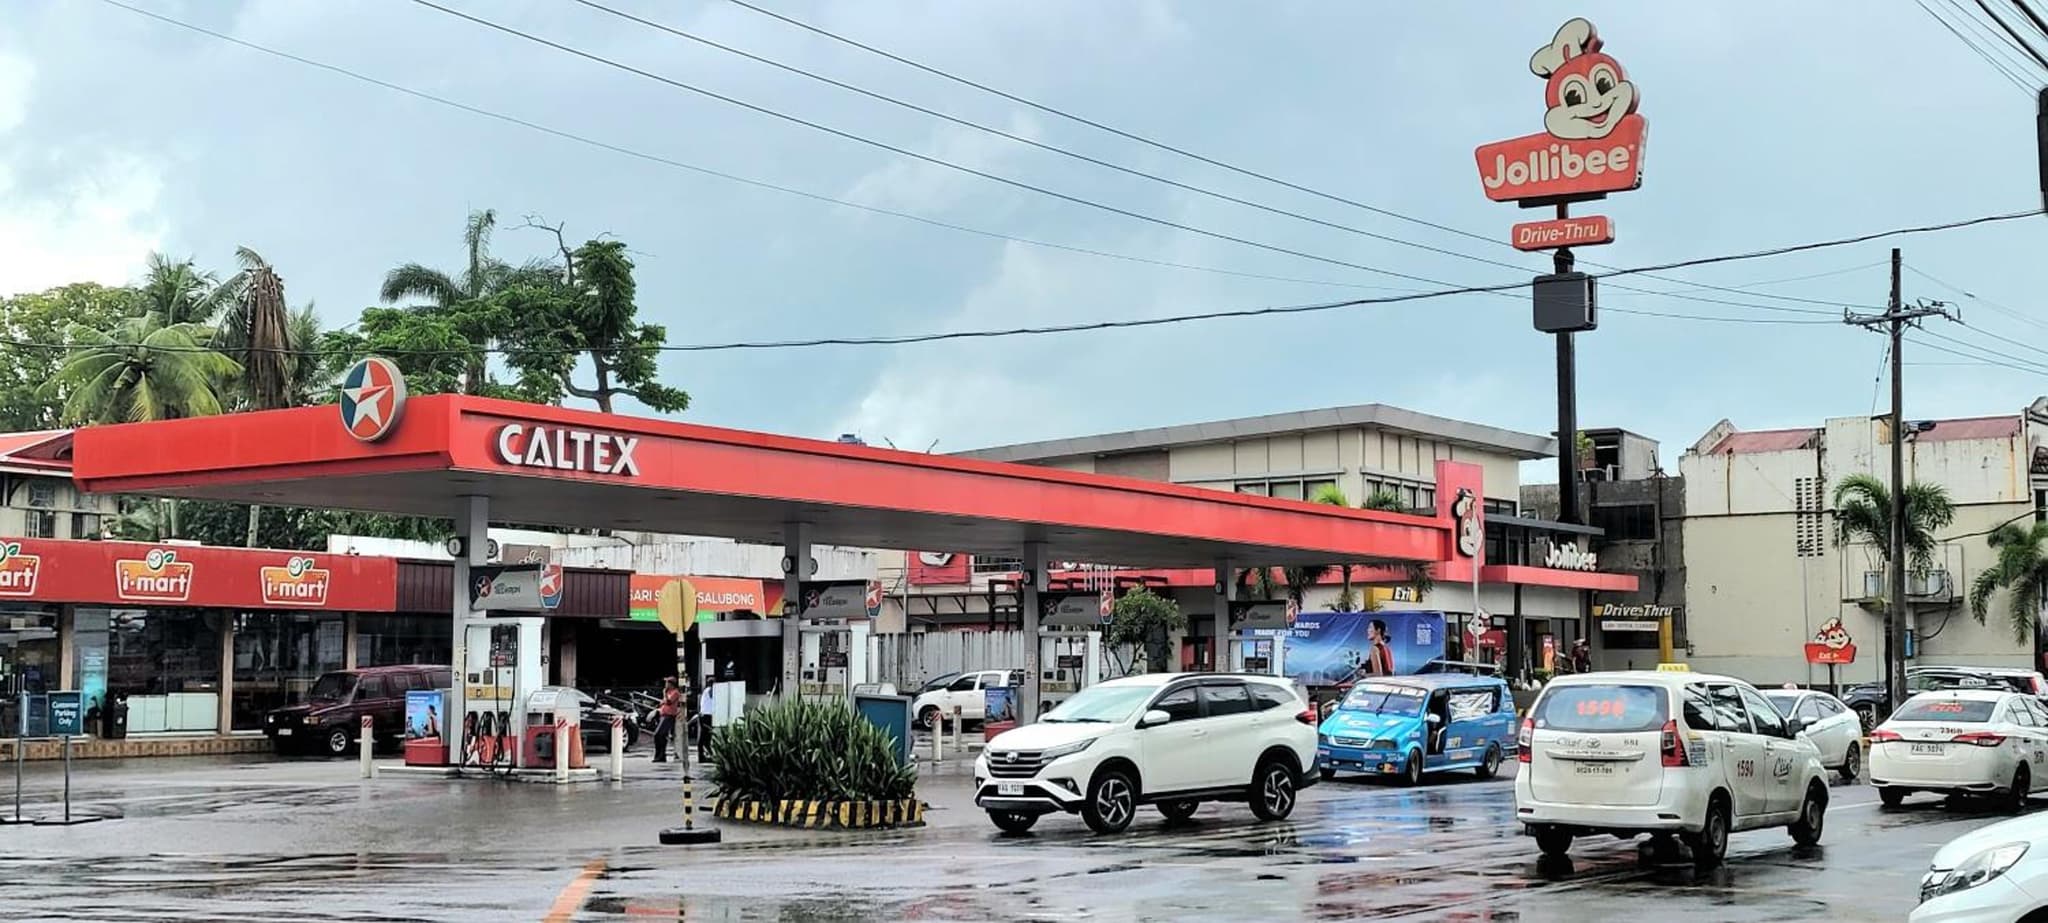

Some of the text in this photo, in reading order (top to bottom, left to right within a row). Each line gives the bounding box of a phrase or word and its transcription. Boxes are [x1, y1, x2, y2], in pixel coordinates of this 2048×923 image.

[1484, 143, 1630, 189] Jollibee
[1519, 223, 1599, 244] Drive-Thru
[499, 423, 640, 476] CALTEX
[1545, 541, 1597, 571] Jollibee
[697, 591, 755, 605] SALUBONG
